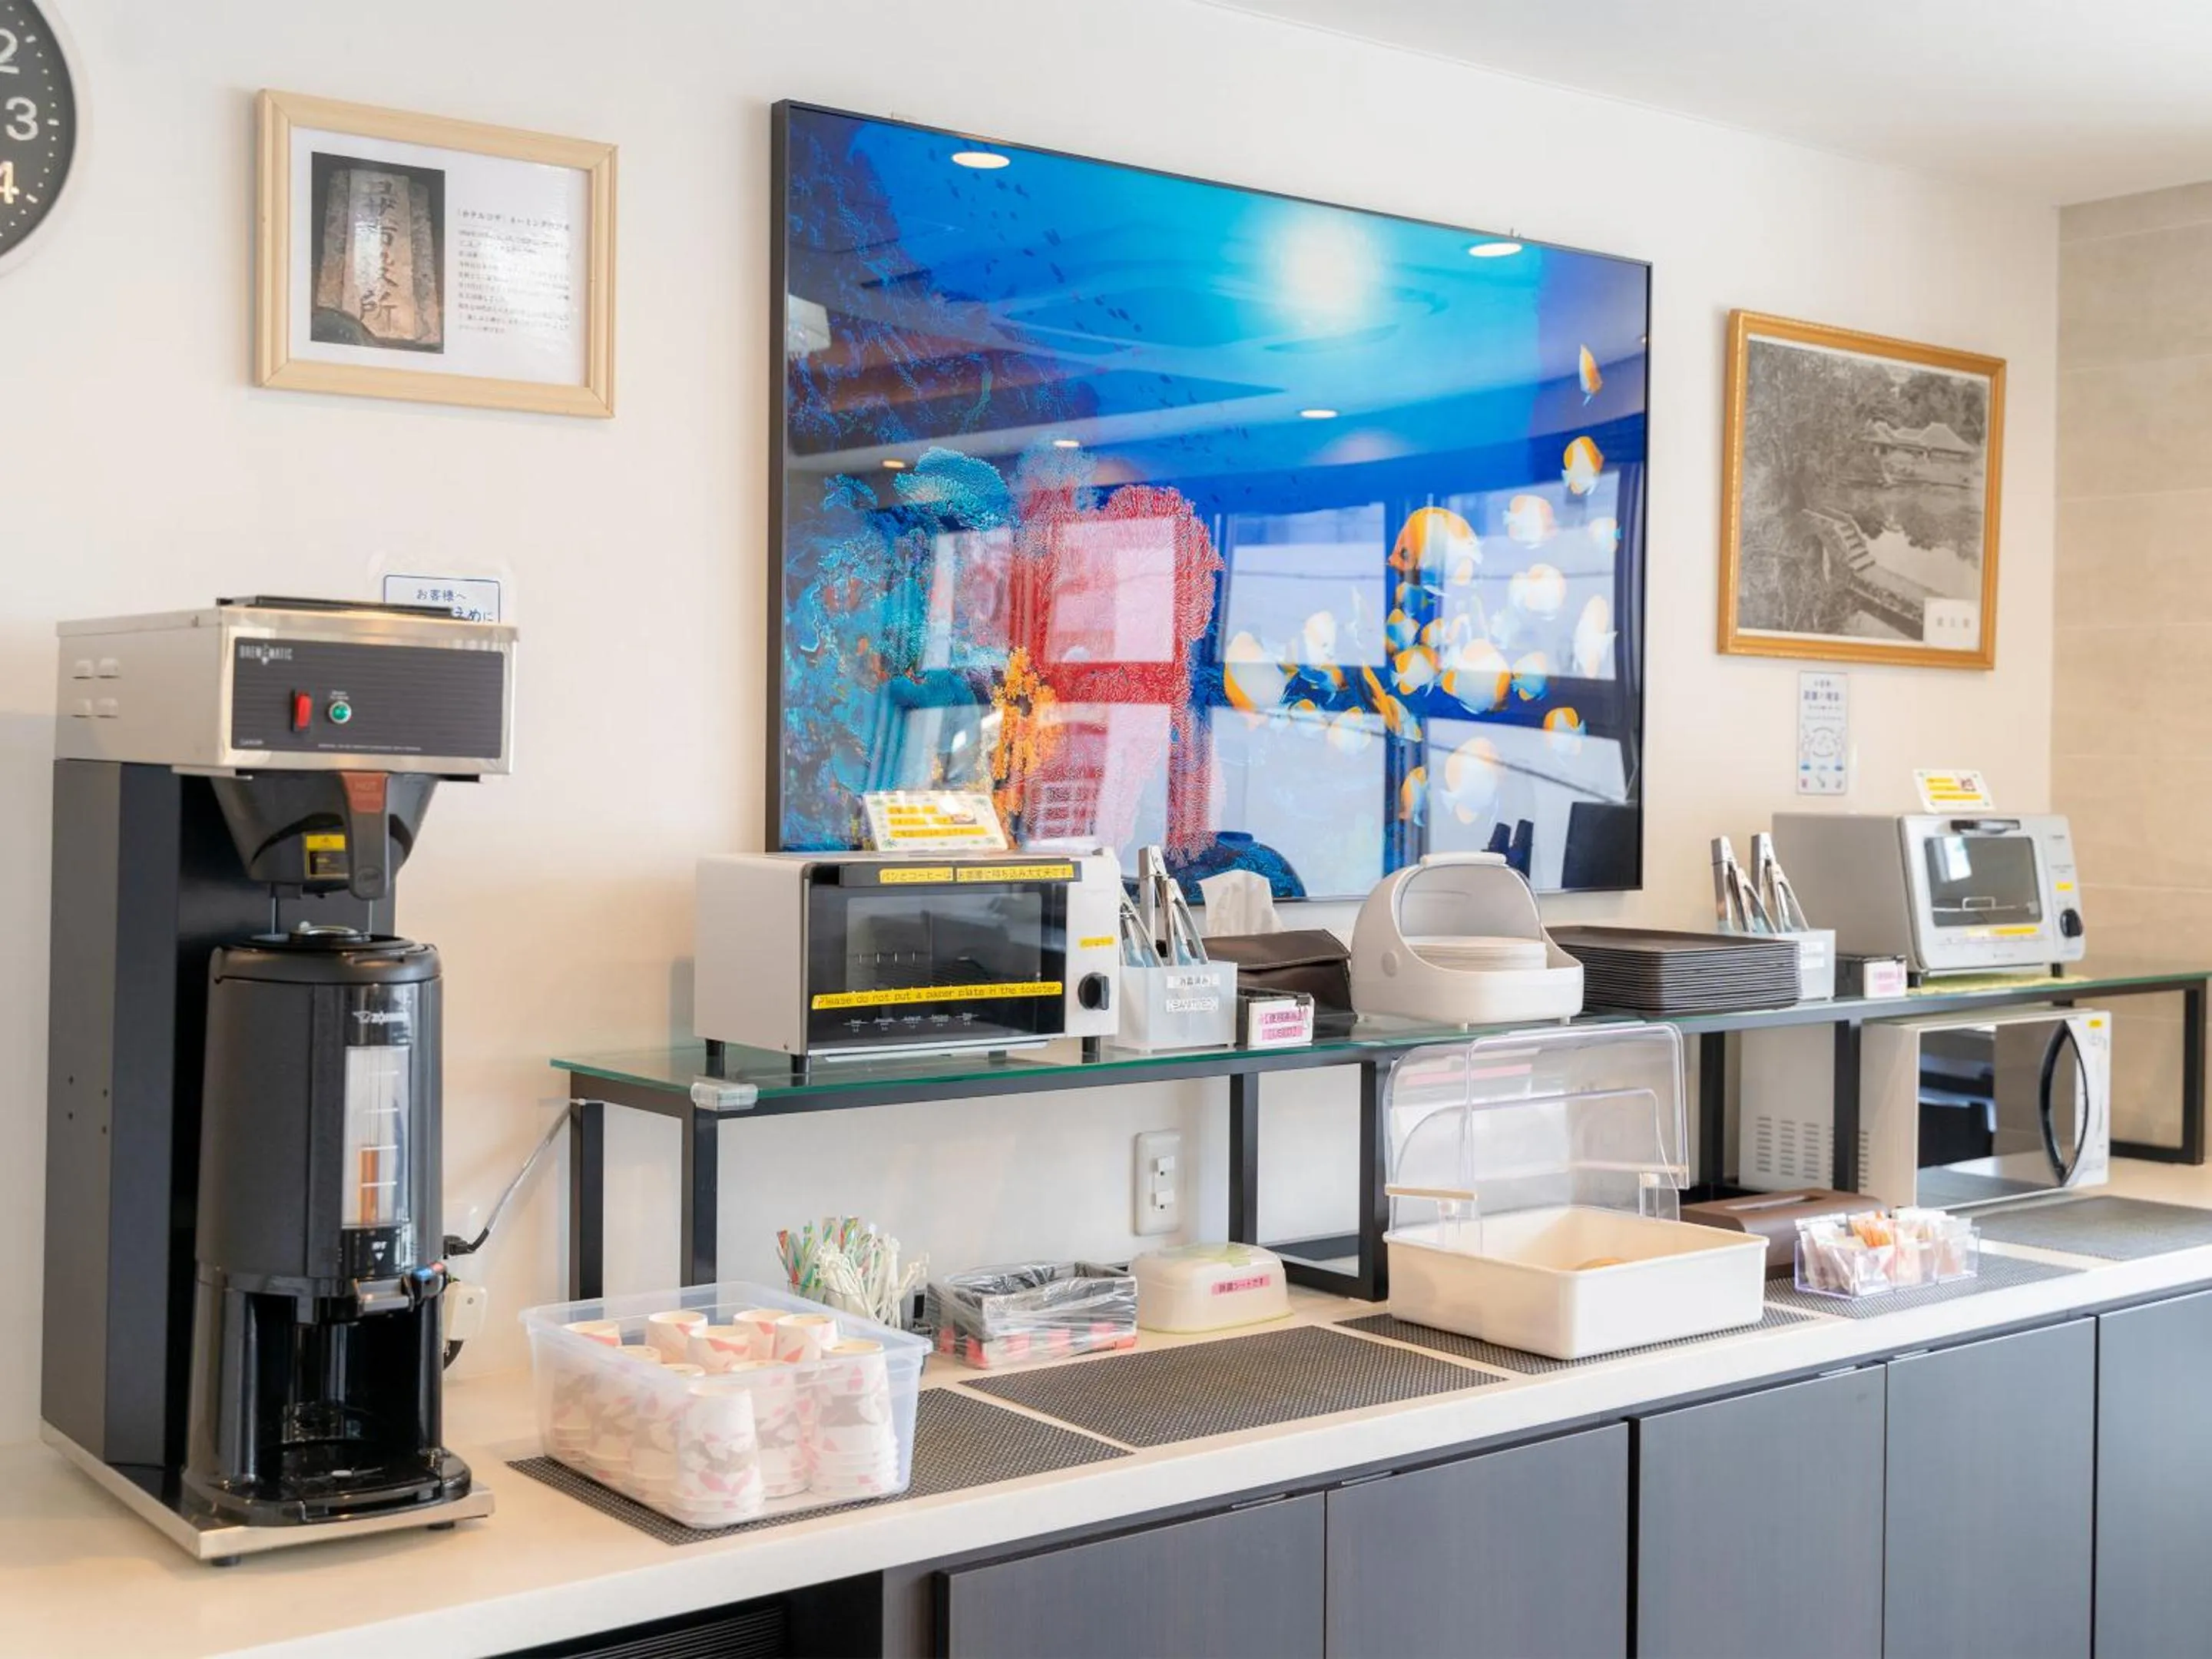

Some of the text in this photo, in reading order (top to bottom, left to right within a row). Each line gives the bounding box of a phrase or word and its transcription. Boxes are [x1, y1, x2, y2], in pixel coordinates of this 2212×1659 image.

[5, 97, 38, 141] 3
[417, 589, 466, 601] お客様へ
